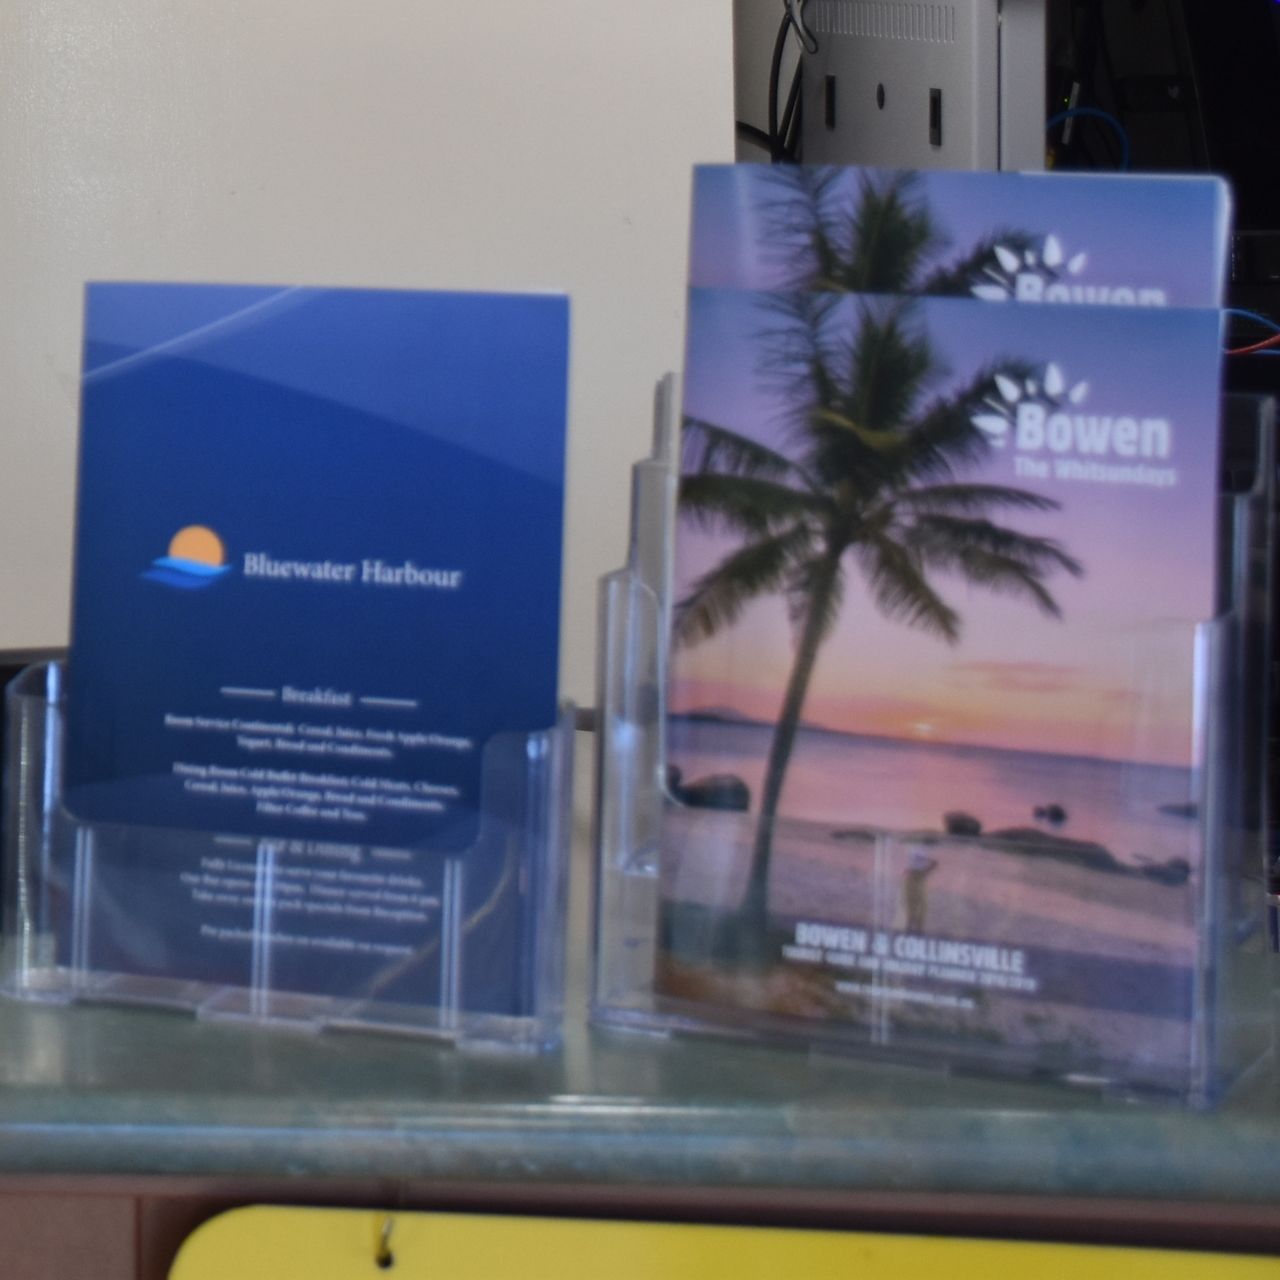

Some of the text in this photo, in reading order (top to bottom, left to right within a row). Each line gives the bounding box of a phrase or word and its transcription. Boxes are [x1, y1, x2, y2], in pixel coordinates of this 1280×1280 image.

[1015, 402, 1171, 458] Bowen
[243, 552, 462, 588] Bluewater Harbour
[281, 685, 352, 708] Breakfast
[795, 922, 868, 953] BOWEN
[893, 934, 1024, 974] COLLINSVILLE
